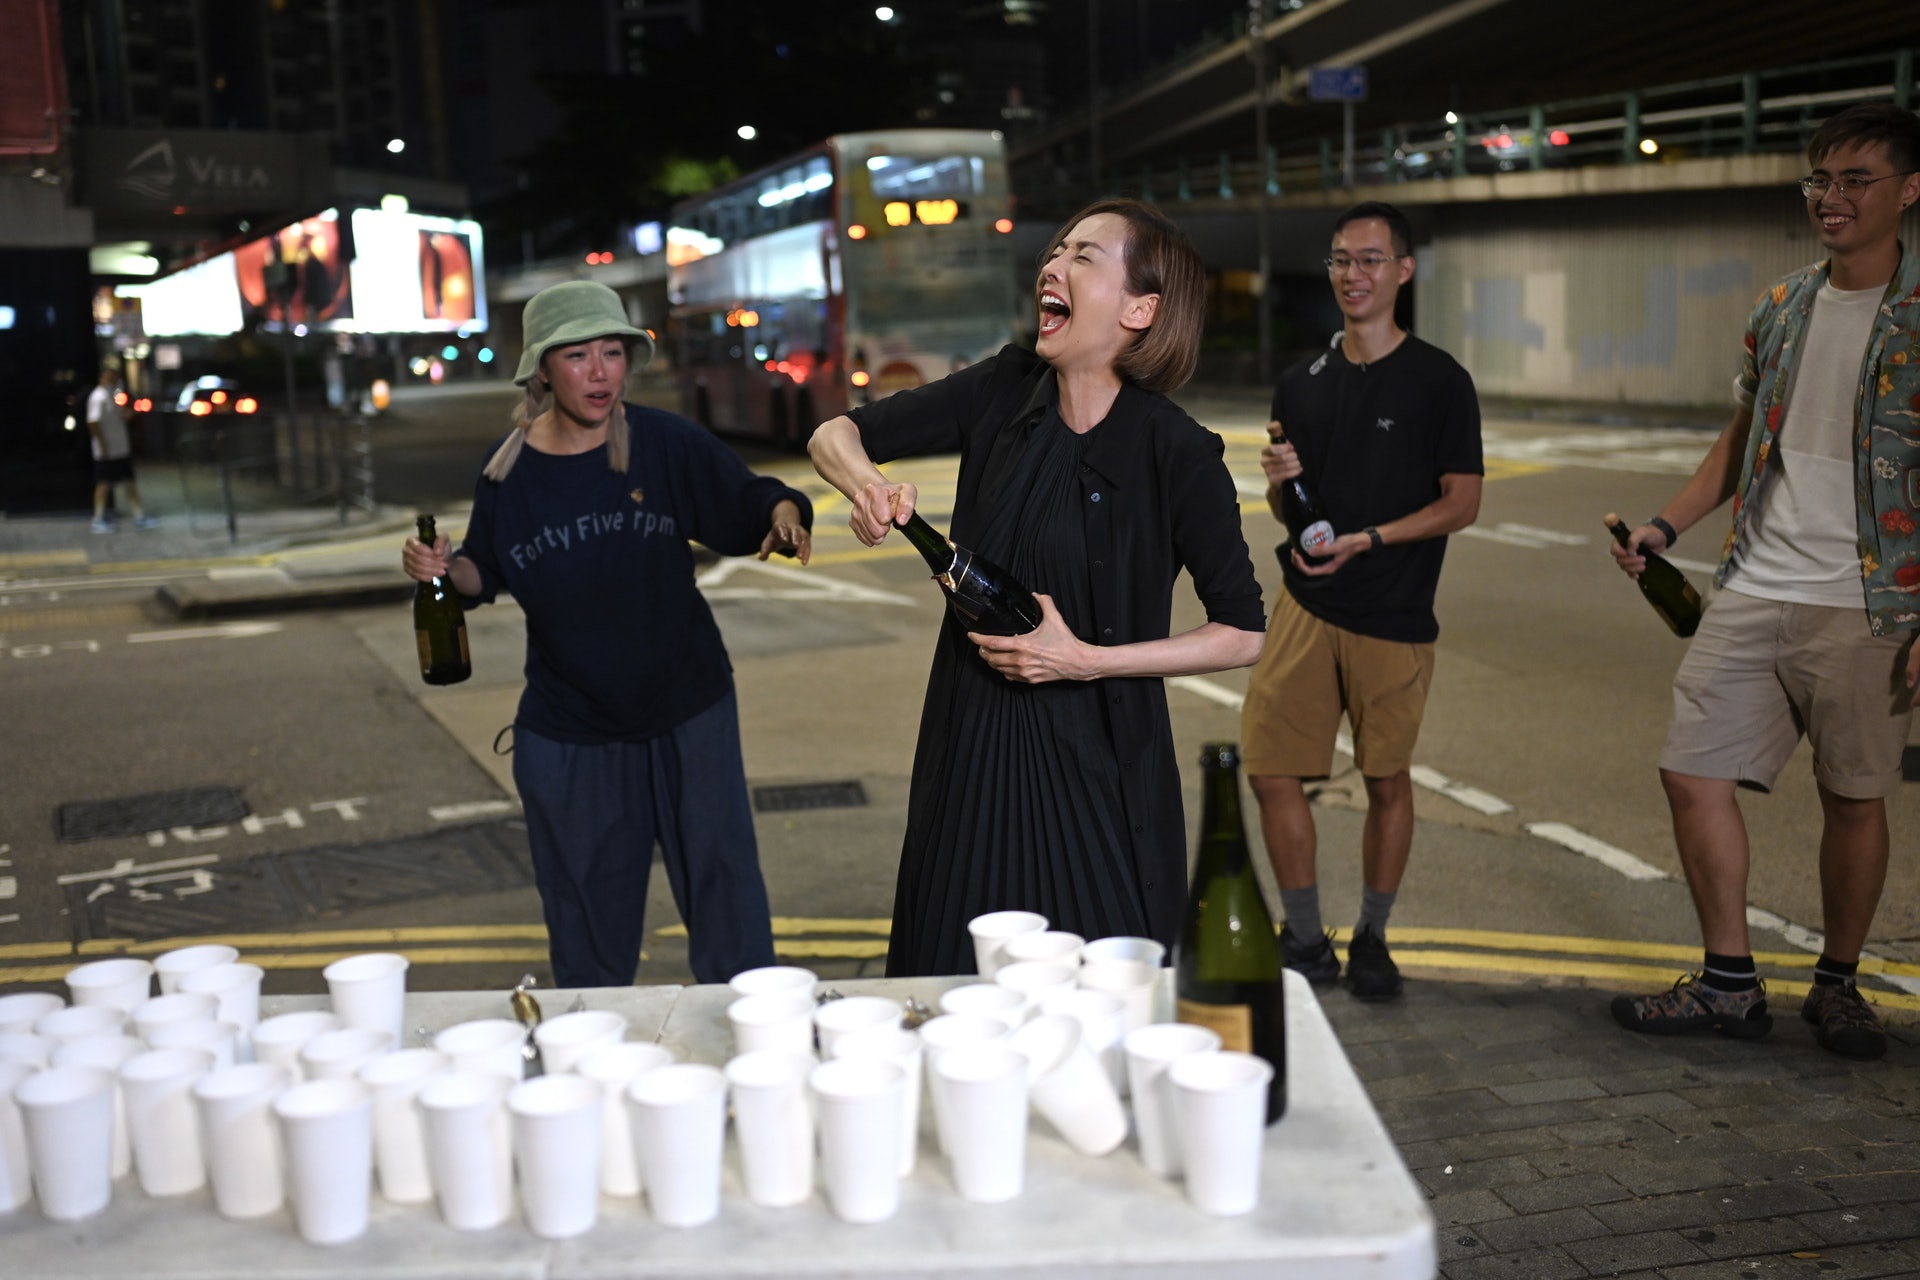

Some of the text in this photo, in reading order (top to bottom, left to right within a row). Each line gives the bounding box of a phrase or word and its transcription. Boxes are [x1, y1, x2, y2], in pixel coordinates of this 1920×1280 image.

[509, 510, 675, 570] Forty Five rpm
[147, 796, 369, 847] IGHT
